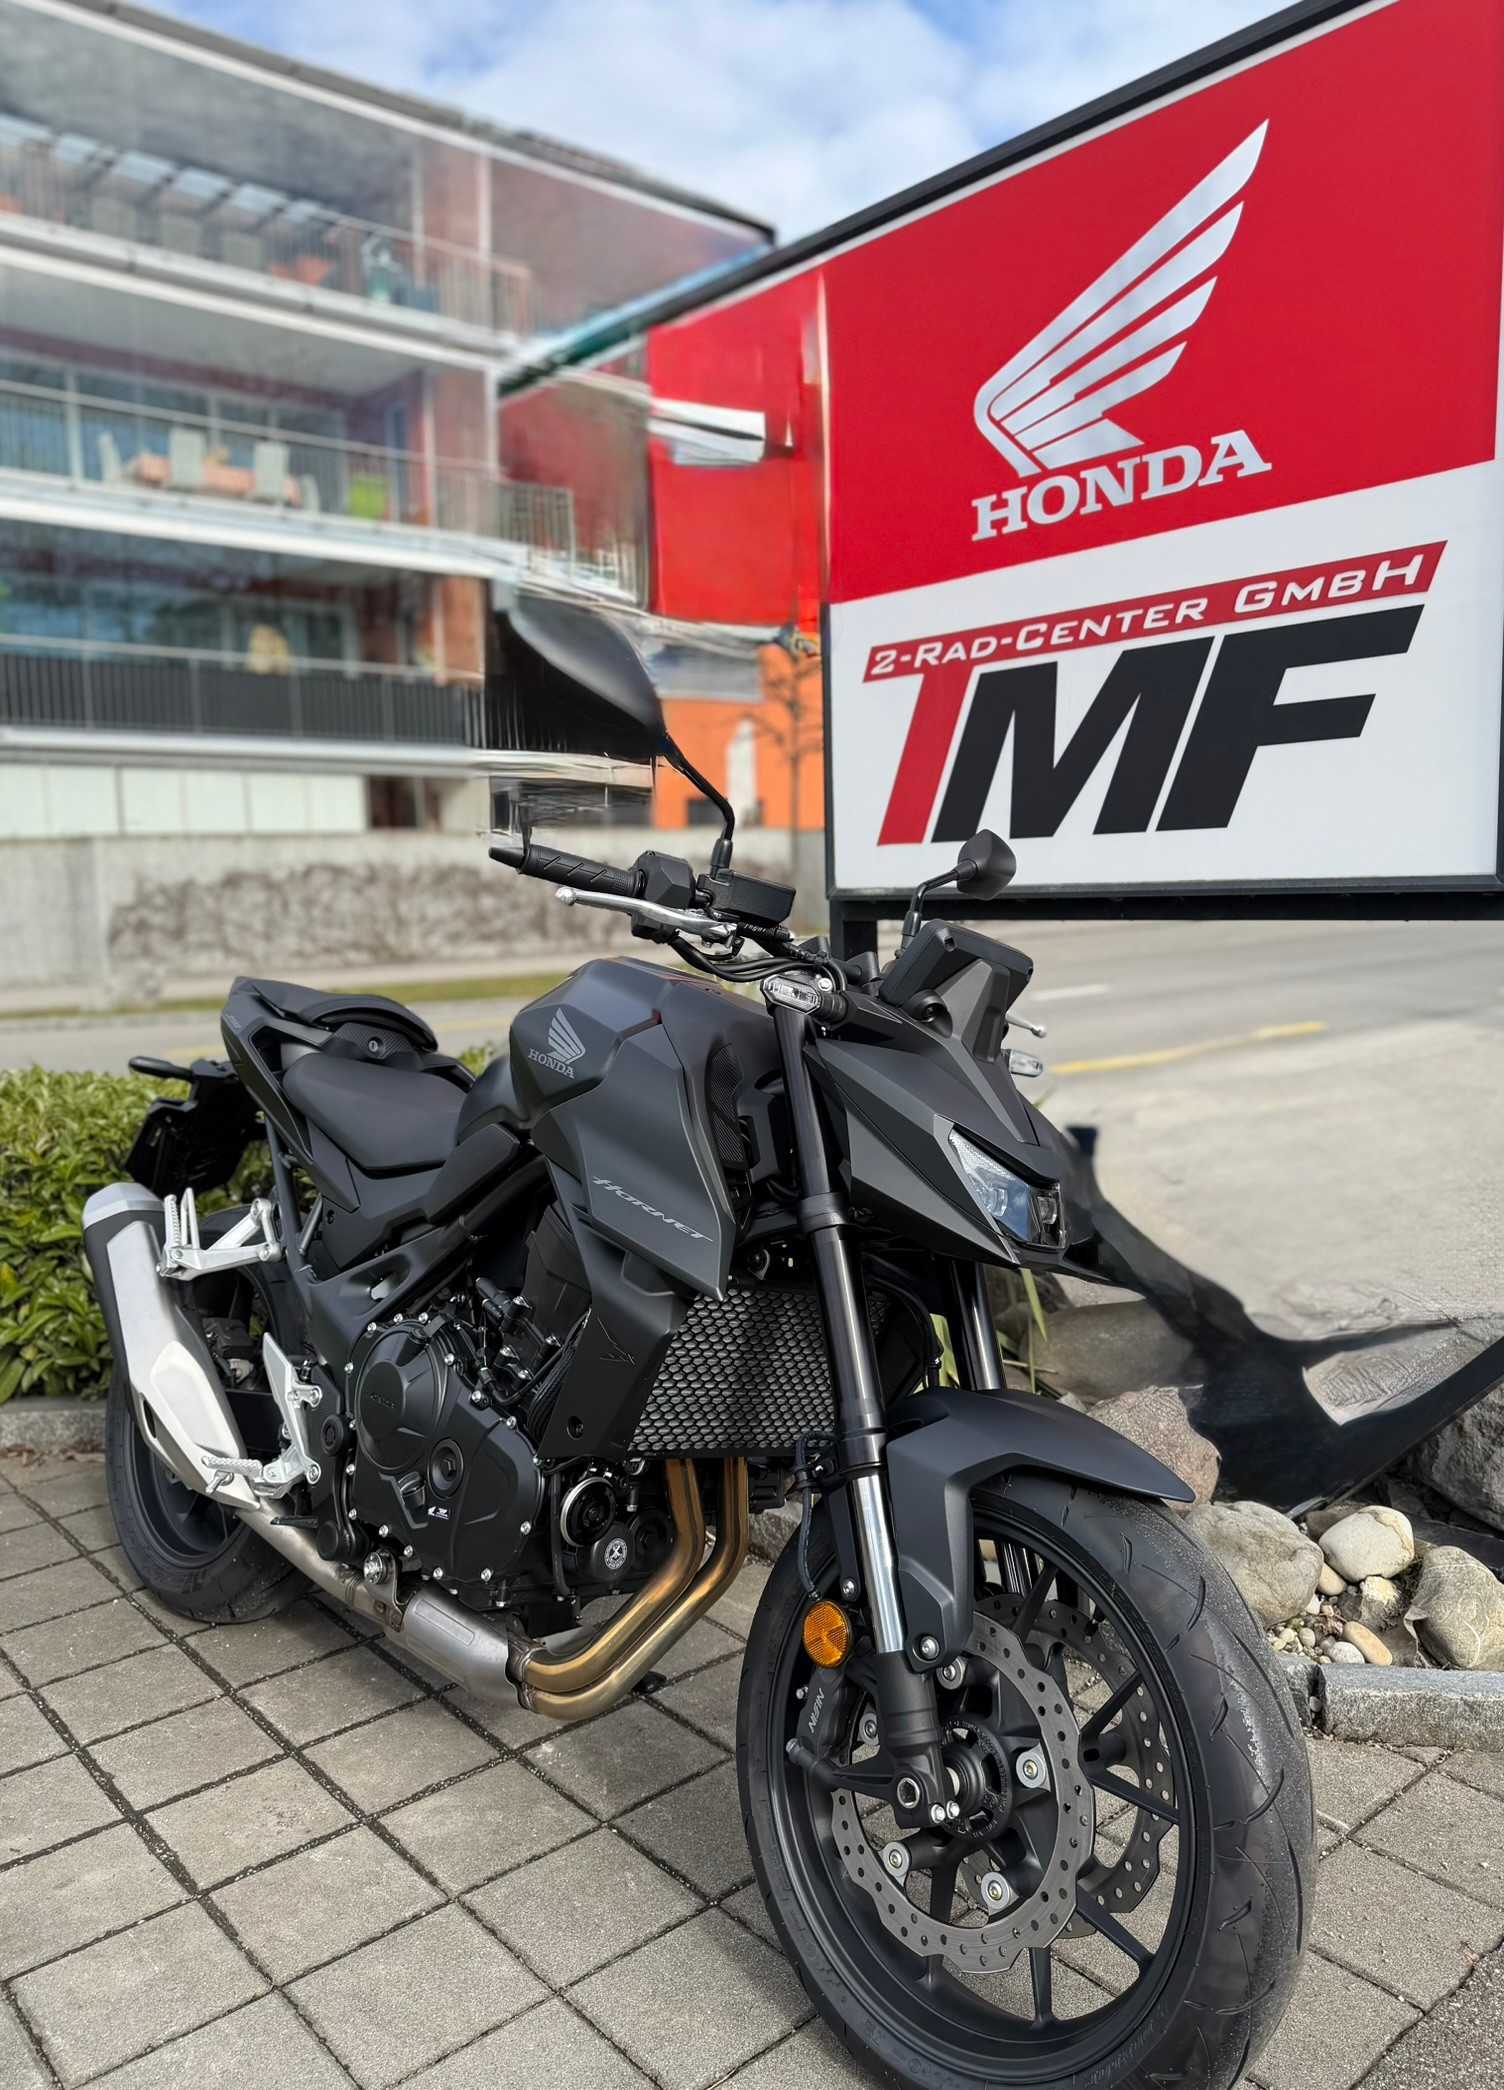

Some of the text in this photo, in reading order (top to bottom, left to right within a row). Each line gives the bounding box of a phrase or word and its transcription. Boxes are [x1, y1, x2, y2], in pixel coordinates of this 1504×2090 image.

[971, 429, 1272, 541] HONDA
[870, 597, 1208, 677] 2-RAD-CENTER
[863, 604, 1425, 846] TMF
[528, 1049, 575, 1079] HONDA
[592, 1175, 714, 1242] HORNET
